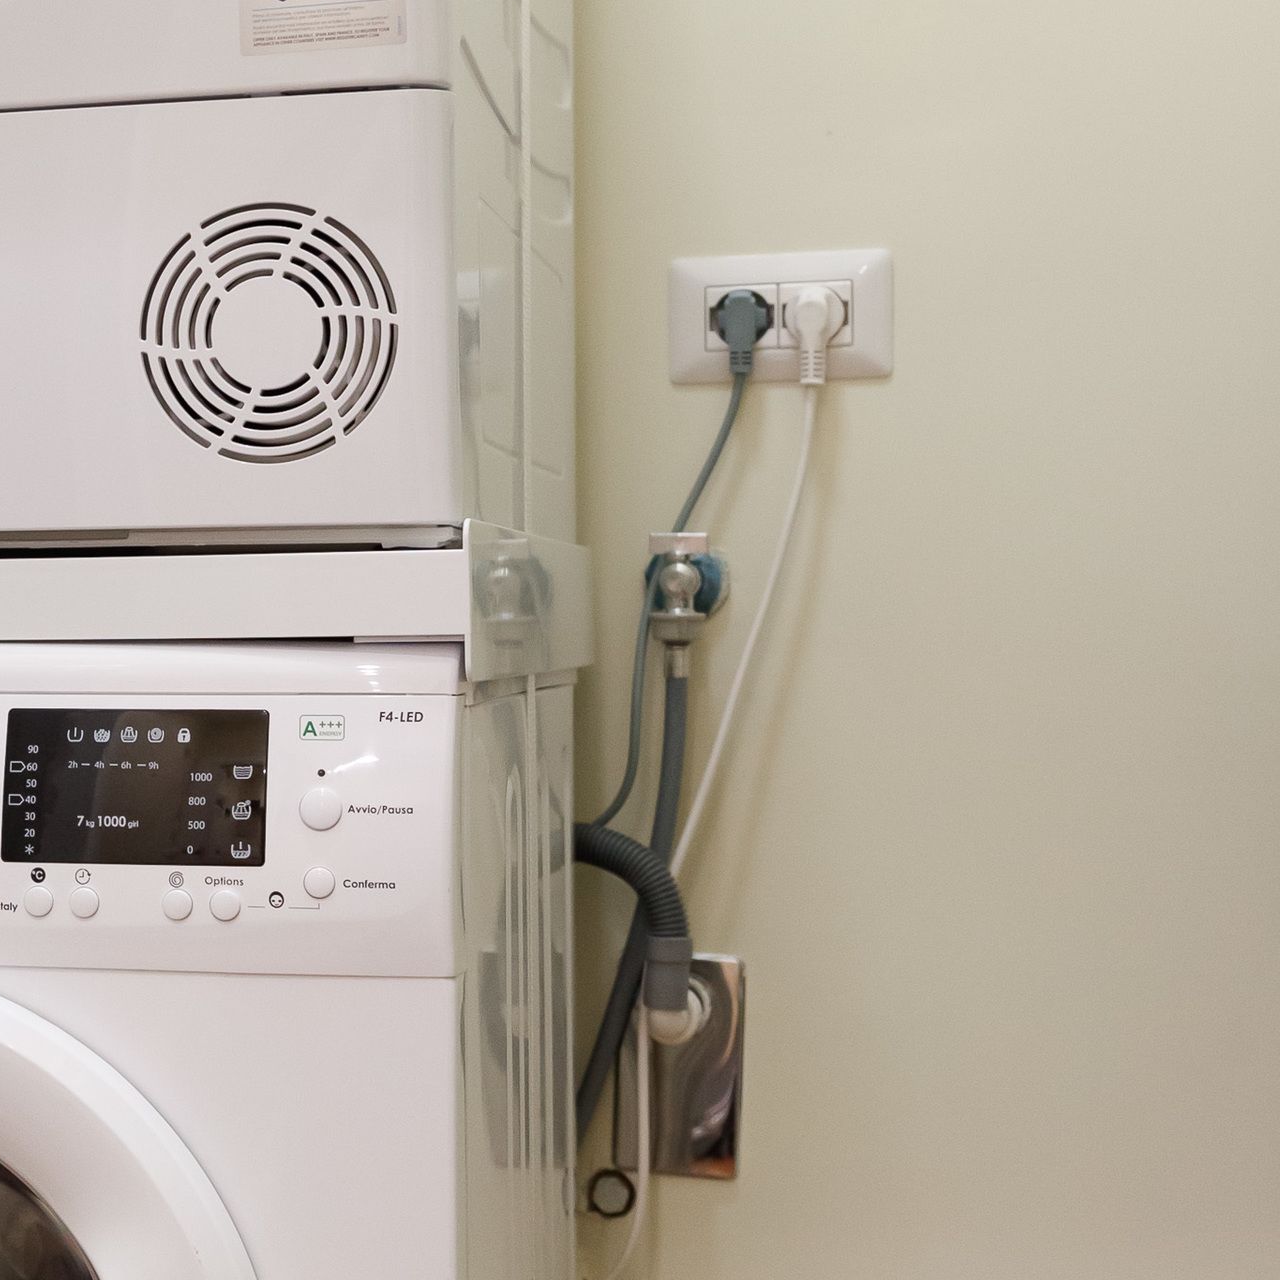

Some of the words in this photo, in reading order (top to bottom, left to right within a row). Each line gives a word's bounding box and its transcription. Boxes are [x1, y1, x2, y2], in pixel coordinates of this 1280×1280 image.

[379, 711, 424, 723] F4-LED
[27, 745, 39, 753] 90
[26, 762, 38, 771] 60
[67, 760, 78, 769] 2h
[94, 761, 105, 769] 4h
[121, 761, 132, 769] 6h
[148, 761, 159, 770] 9h
[189, 773, 213, 782] 1000
[26, 779, 37, 788] 50
[25, 795, 37, 804] 40
[188, 797, 206, 806] 800
[347, 804, 414, 815] Avvio/Pausa
[24, 812, 36, 821] 30
[77, 815, 84, 827] 7
[85, 820, 95, 828] kg
[97, 815, 127, 827] 1000
[187, 821, 206, 830] 500
[24, 829, 35, 838] 20
[187, 845, 194, 855] 0
[204, 876, 244, 886] Options
[343, 879, 396, 890] Conferma
